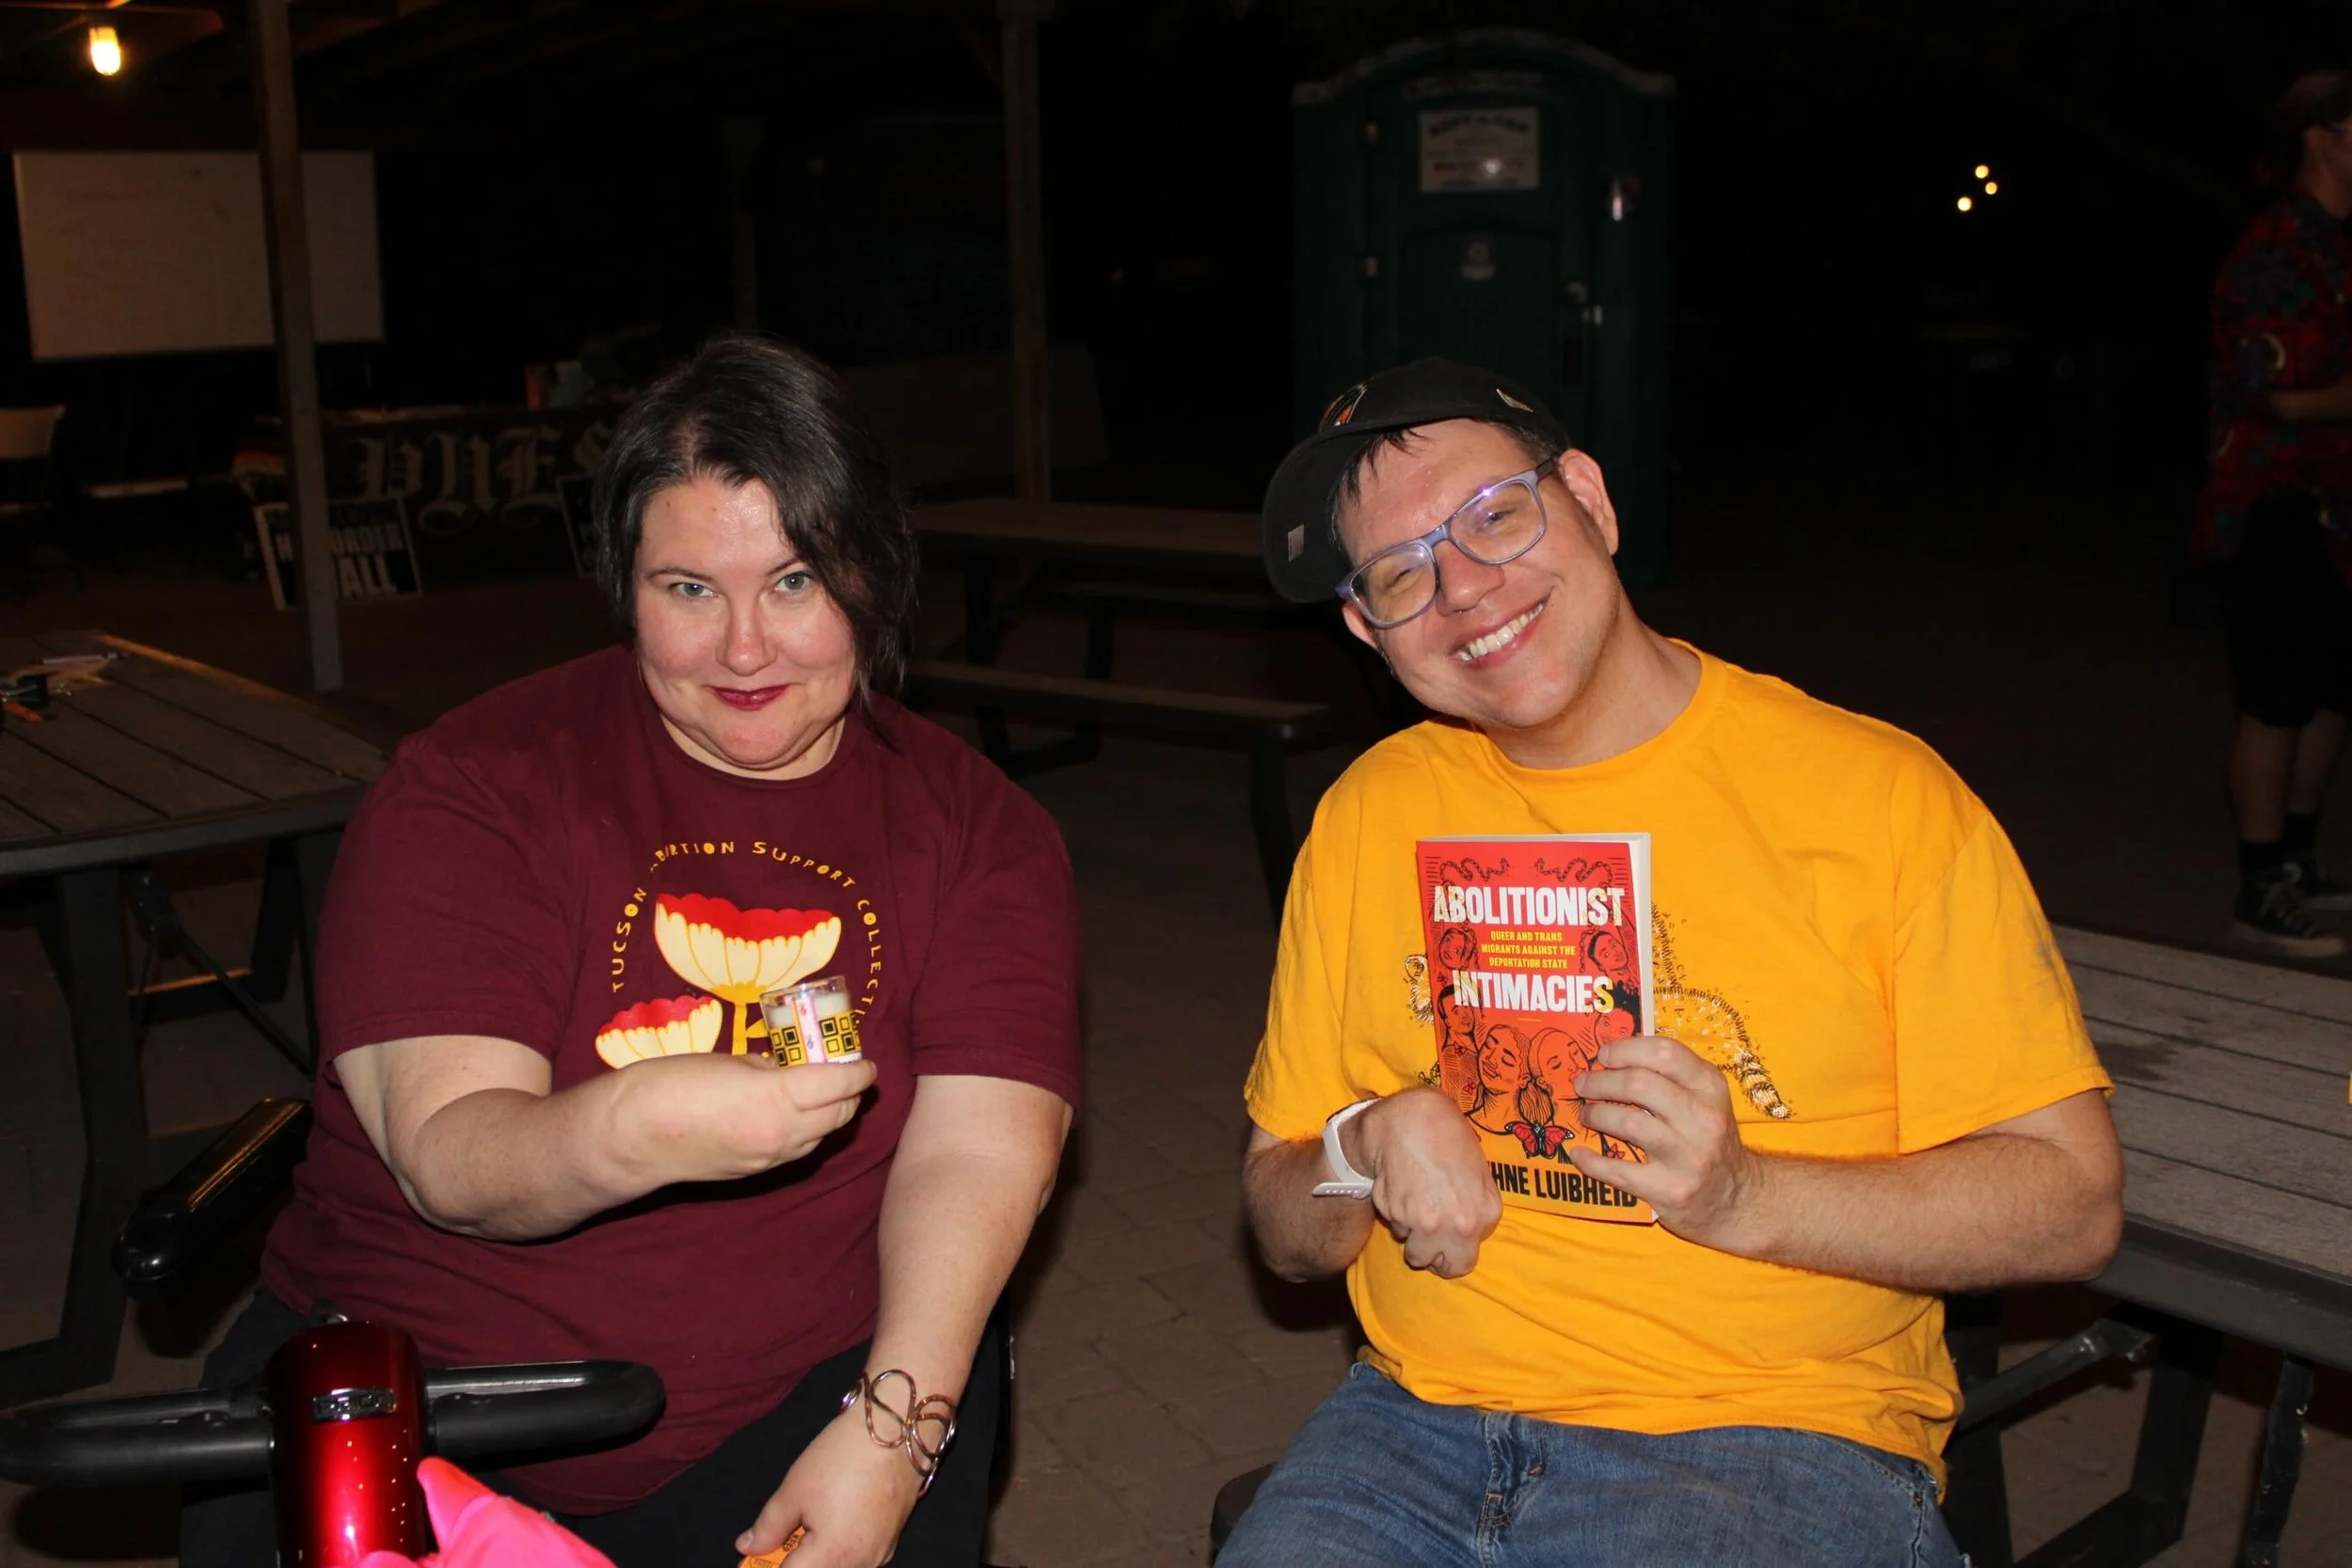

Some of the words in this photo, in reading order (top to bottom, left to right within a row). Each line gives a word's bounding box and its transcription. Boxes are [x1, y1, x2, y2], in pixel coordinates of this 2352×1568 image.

[338, 551, 398, 600] ALL
[611, 887, 646, 993] TUCSON
[649, 841, 736, 872] BRTION
[752, 841, 856, 889] SUPPORT
[1434, 885, 1625, 927] ABOLITIONIST
[1481, 943, 1521, 955] MIGRANTS
[1522, 945, 1558, 956] AGAINST
[1560, 945, 1577, 957] THE
[1490, 930, 1516, 942] QUEER
[1517, 931, 1534, 942] AND
[1535, 931, 1564, 942] TRANS
[1488, 957, 1541, 969] DEPORTATION
[1542, 958, 1568, 970] STATE
[1452, 970, 1614, 1014] INTIMACIES
[1489, 1161, 1531, 1196] HNE
